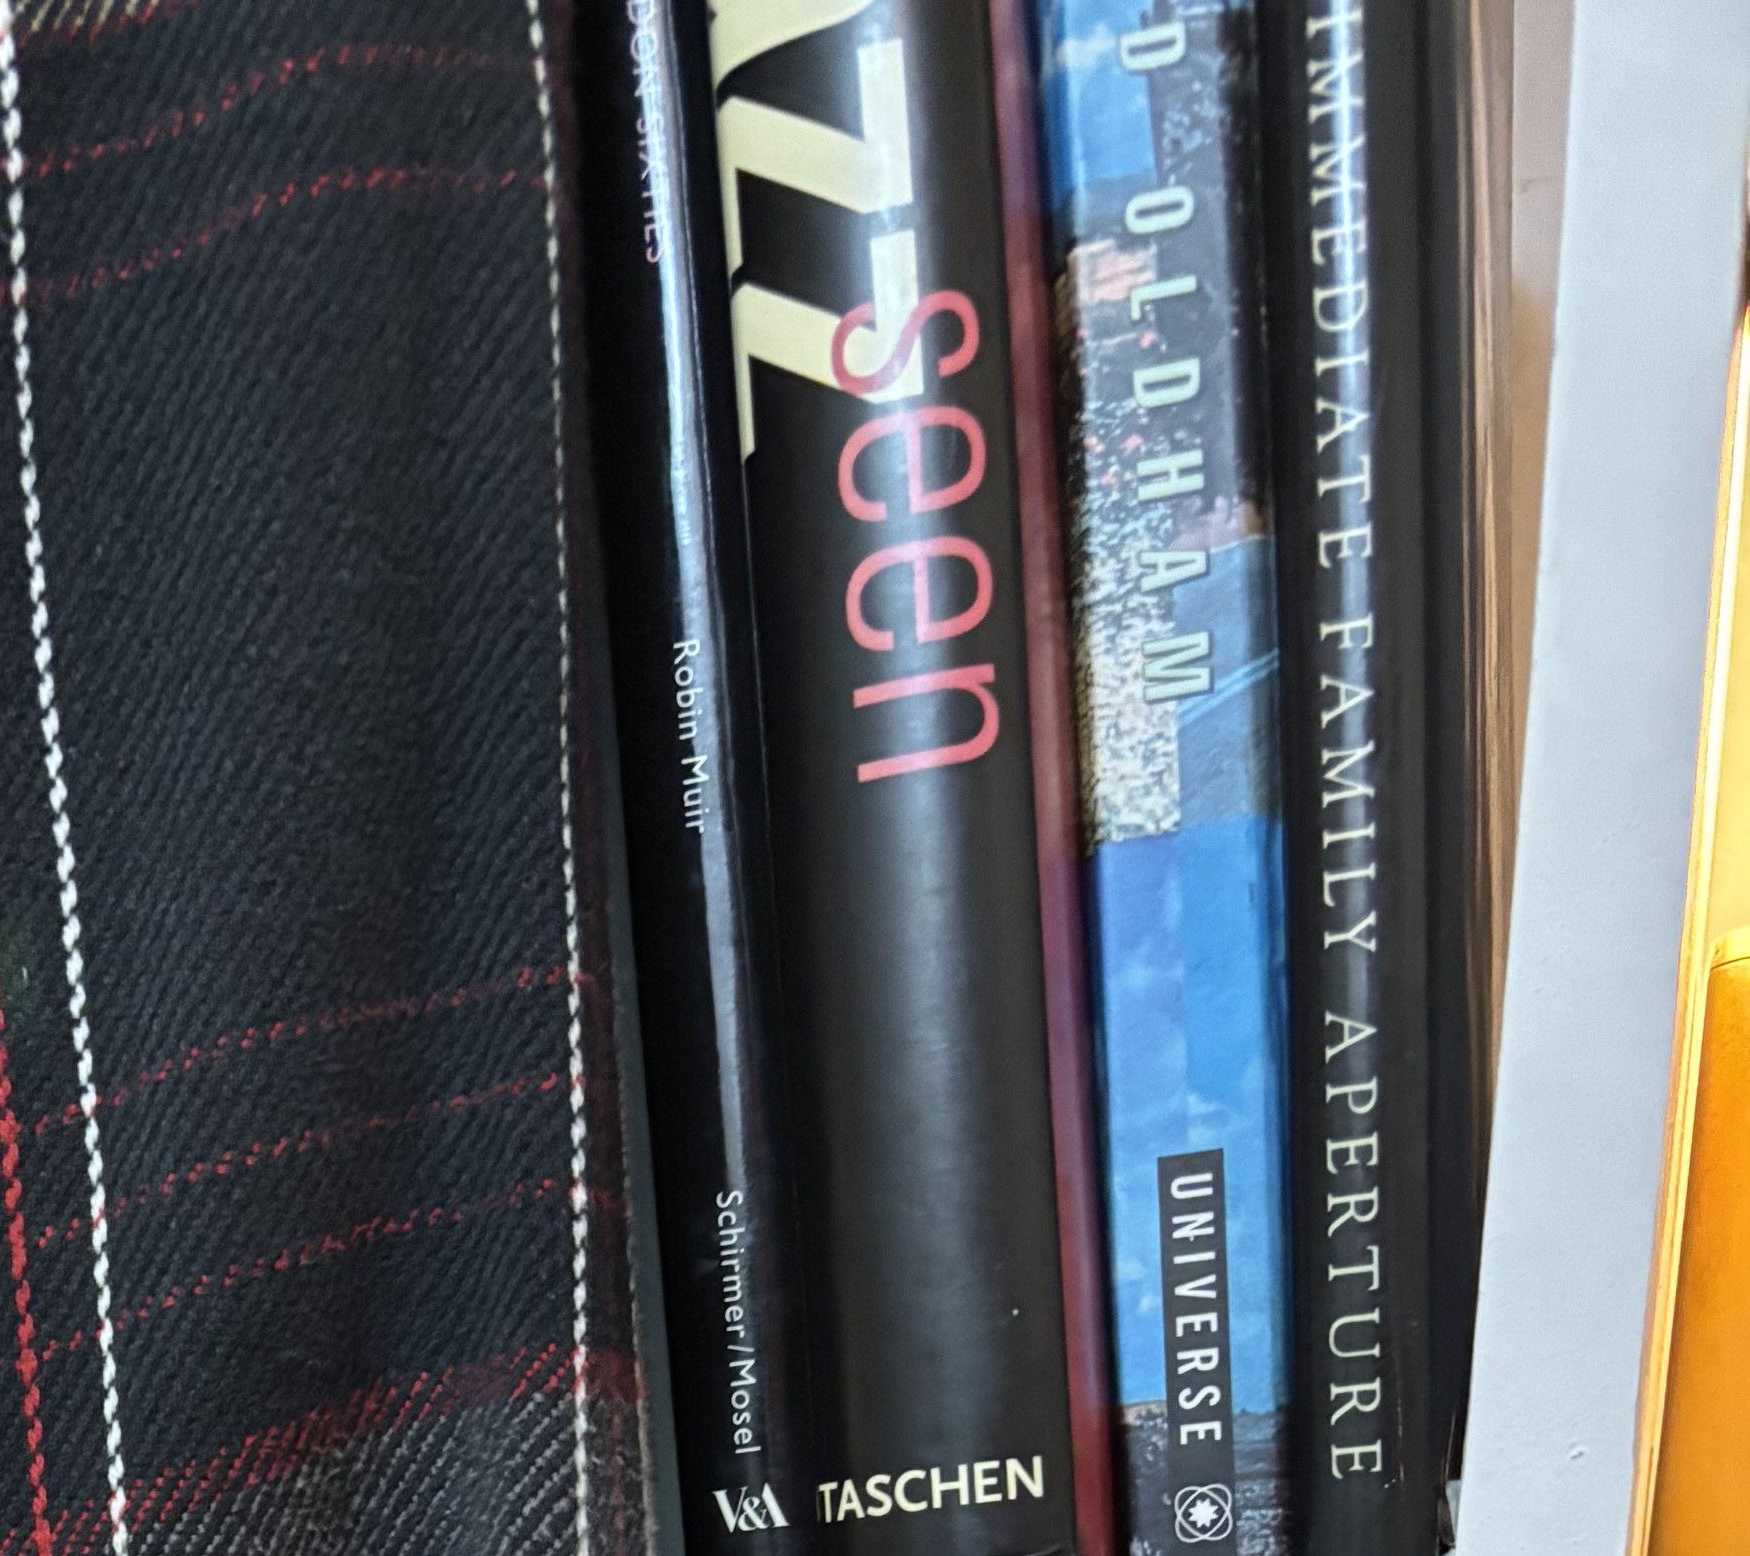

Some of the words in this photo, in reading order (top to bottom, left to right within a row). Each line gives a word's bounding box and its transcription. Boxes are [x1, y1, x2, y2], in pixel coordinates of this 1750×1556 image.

[1305, 7, 1374, 570] IMMEDIATE
[830, 289, 1002, 784] Seen
[1124, 183, 1215, 704] OLDHAM
[672, 639, 700, 740] Robin
[681, 755, 707, 834] Muir
[1319, 614, 1378, 953] FAMILY
[1170, 1172, 1222, 1445] UNIVERSE
[1324, 1008, 1384, 1481] APERTURE
[712, 1482, 791, 1533] V&A
[816, 1455, 1044, 1524] TASCHEN
